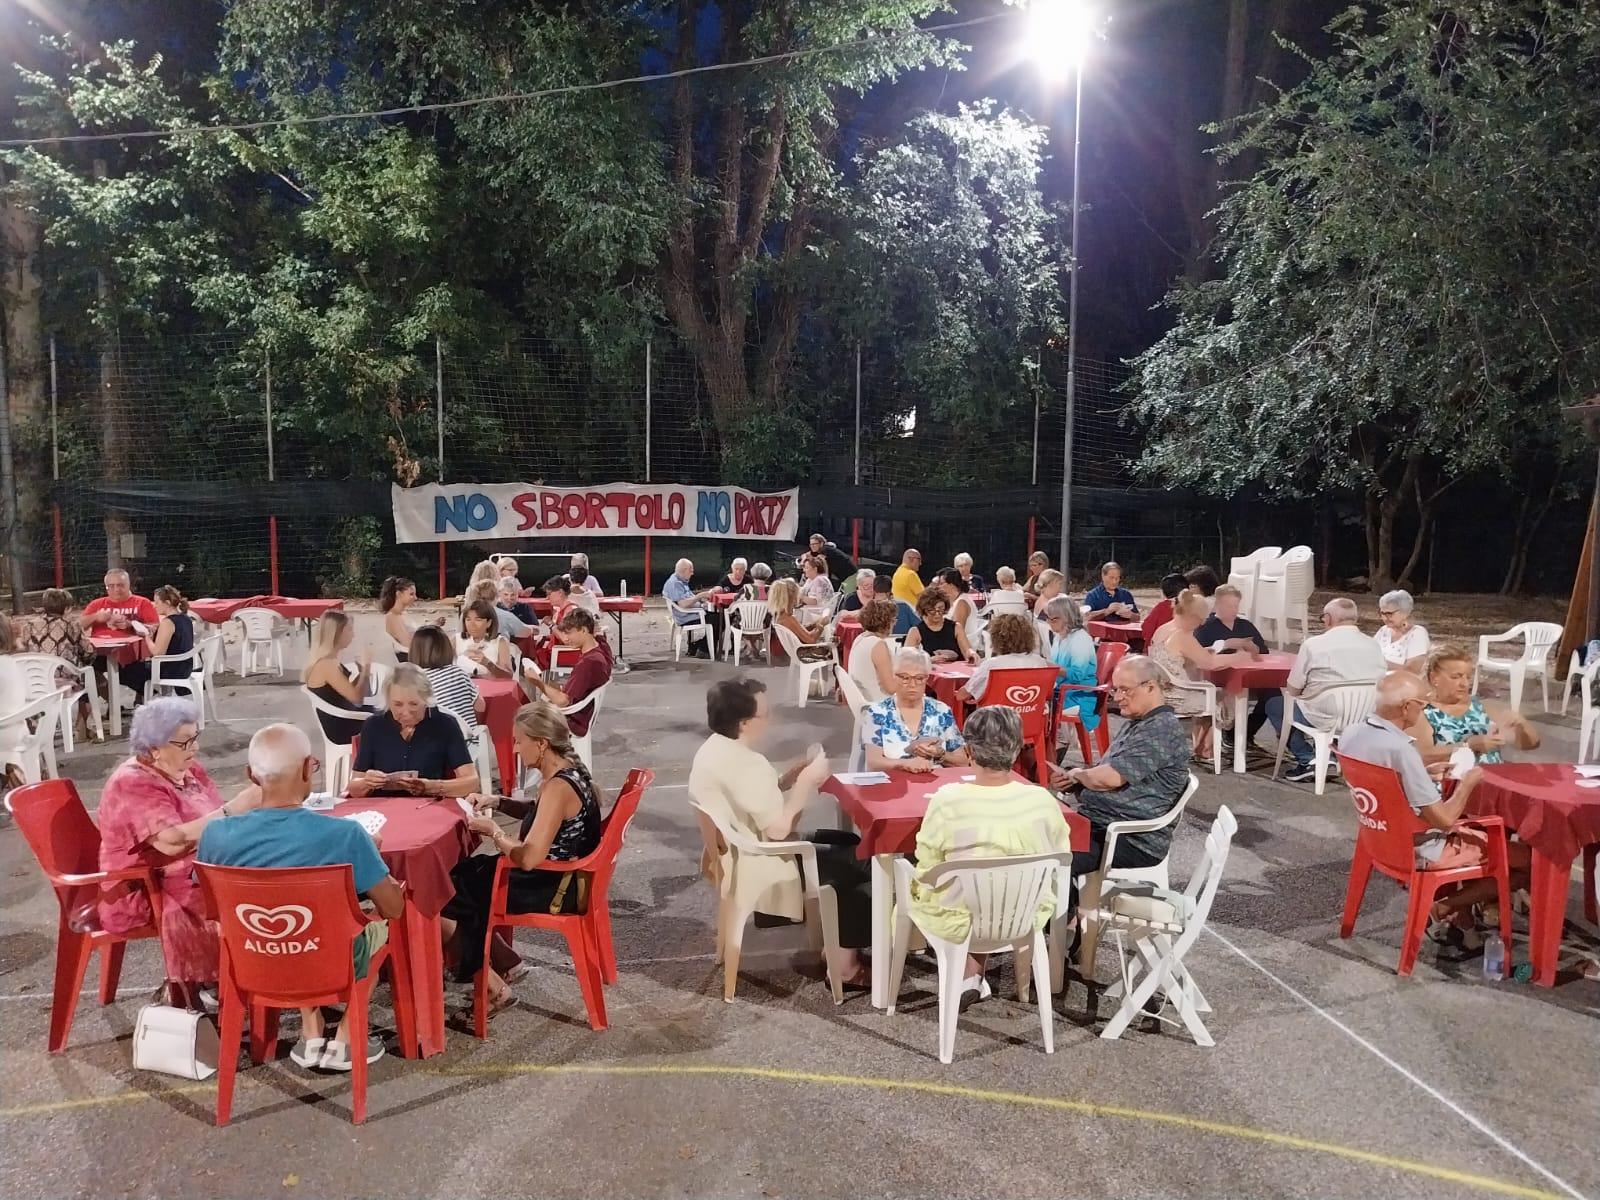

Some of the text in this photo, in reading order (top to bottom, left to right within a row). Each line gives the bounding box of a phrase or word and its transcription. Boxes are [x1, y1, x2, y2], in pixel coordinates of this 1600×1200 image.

[434, 491, 791, 535] NO S.BORTOLO NO PARTY
[244, 938, 320, 955] ALGIDA
